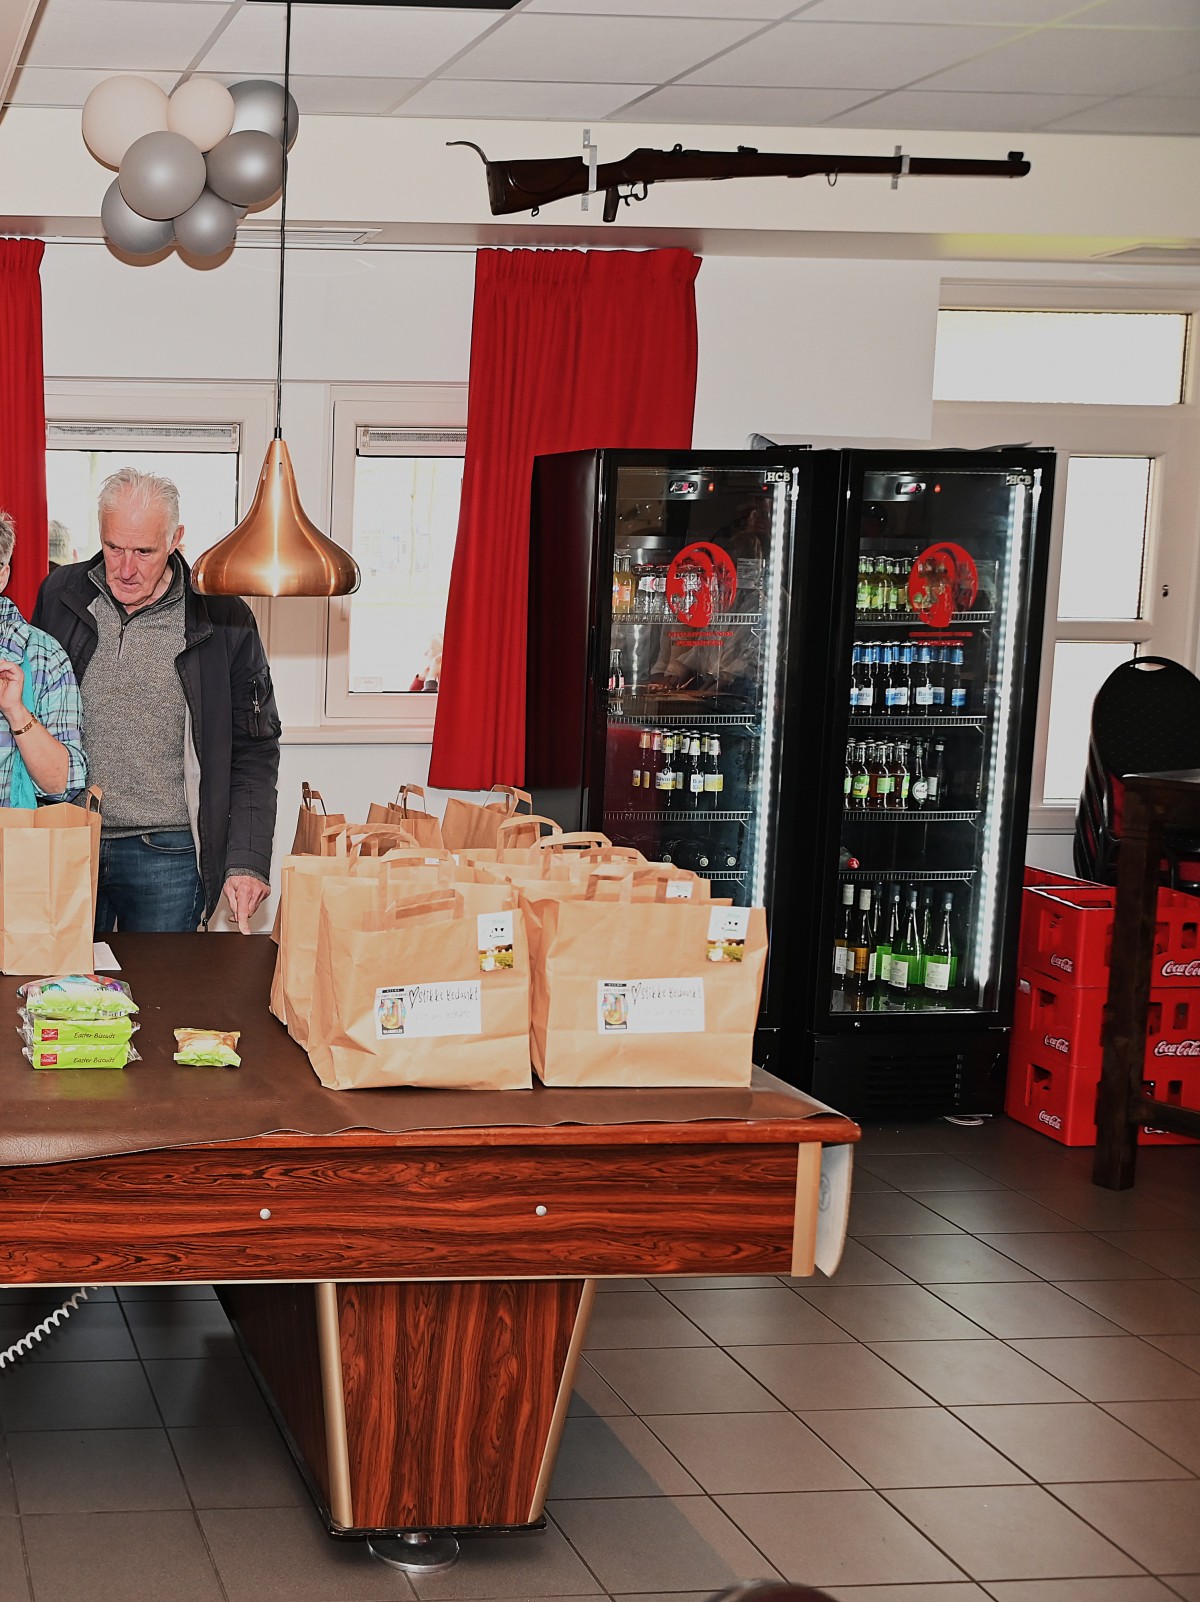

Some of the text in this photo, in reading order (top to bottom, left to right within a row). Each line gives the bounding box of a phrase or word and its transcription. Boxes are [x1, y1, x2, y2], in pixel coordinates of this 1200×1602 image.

[767, 471, 791, 483] HCB
[1009, 474, 1032, 486] HCB
[73, 1031, 93, 1039] Easter
